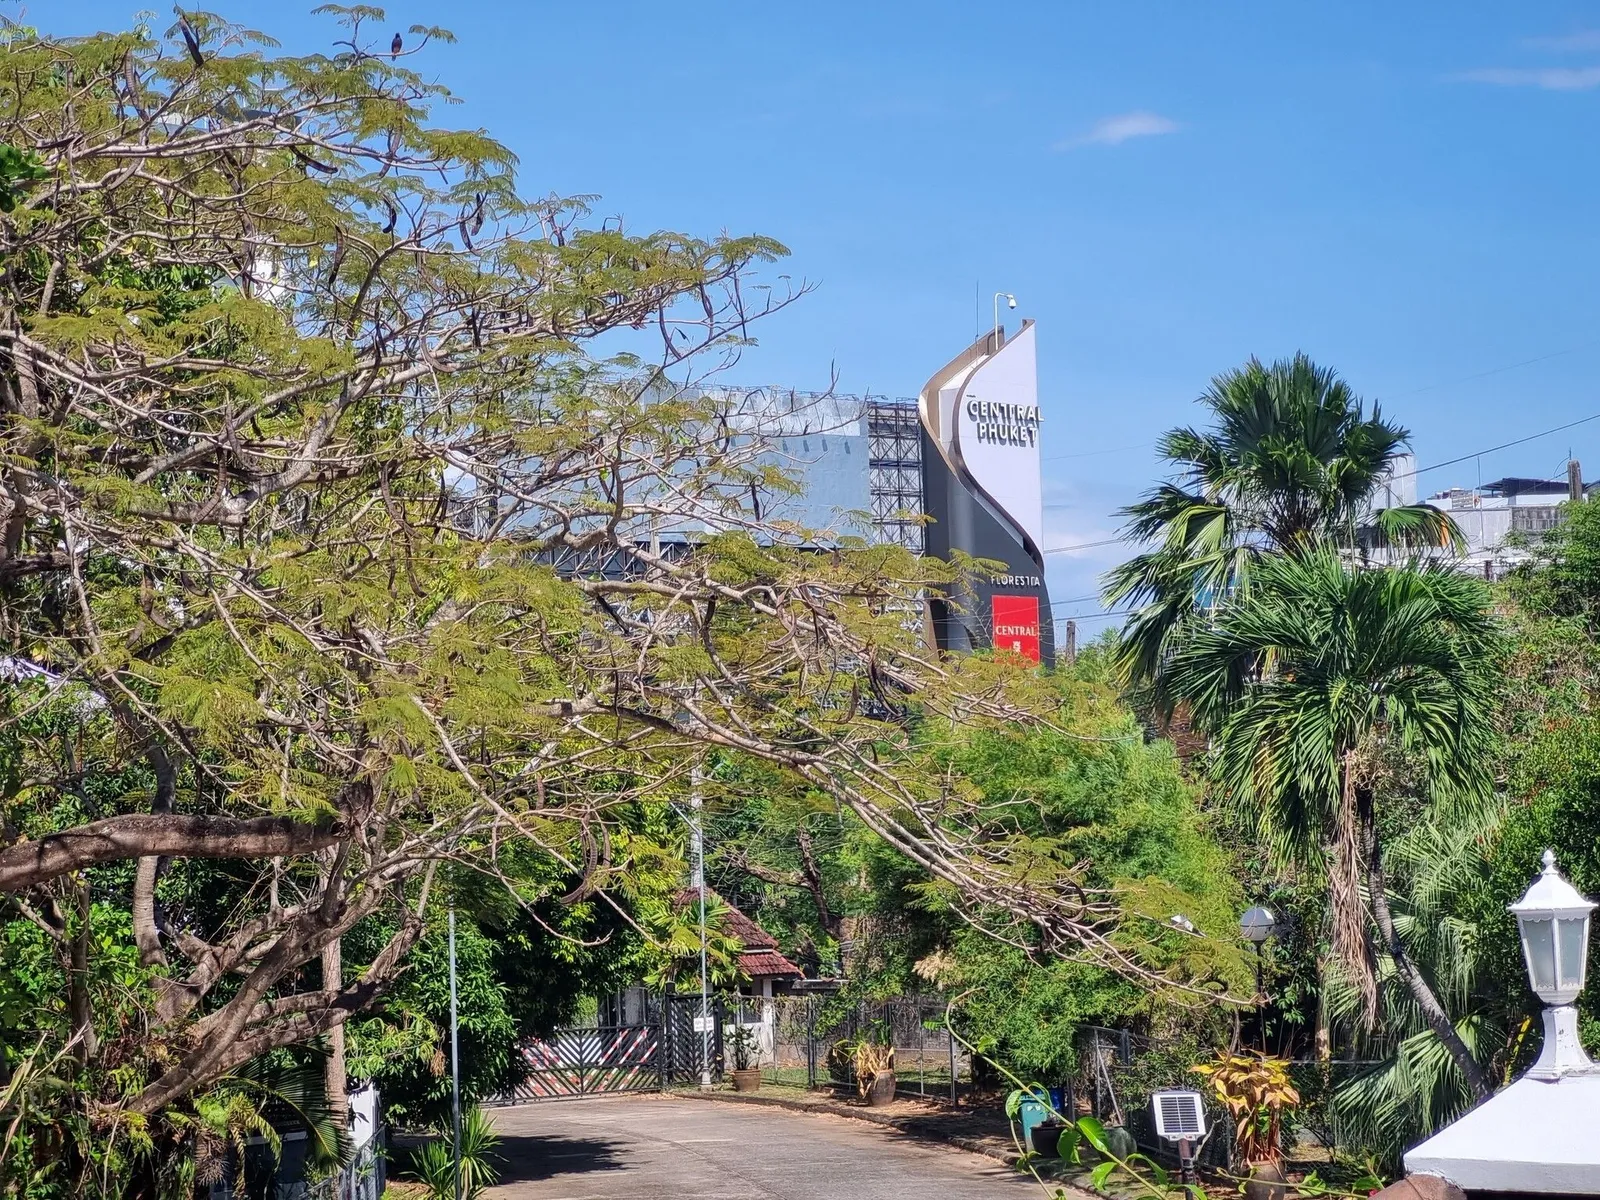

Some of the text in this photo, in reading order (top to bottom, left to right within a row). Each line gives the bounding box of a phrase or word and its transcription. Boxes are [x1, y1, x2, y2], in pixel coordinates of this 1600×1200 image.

[967, 400, 1045, 422] CENTRAL
[977, 423, 1038, 443] PHUKET
[995, 625, 1037, 636] CENTRAL
